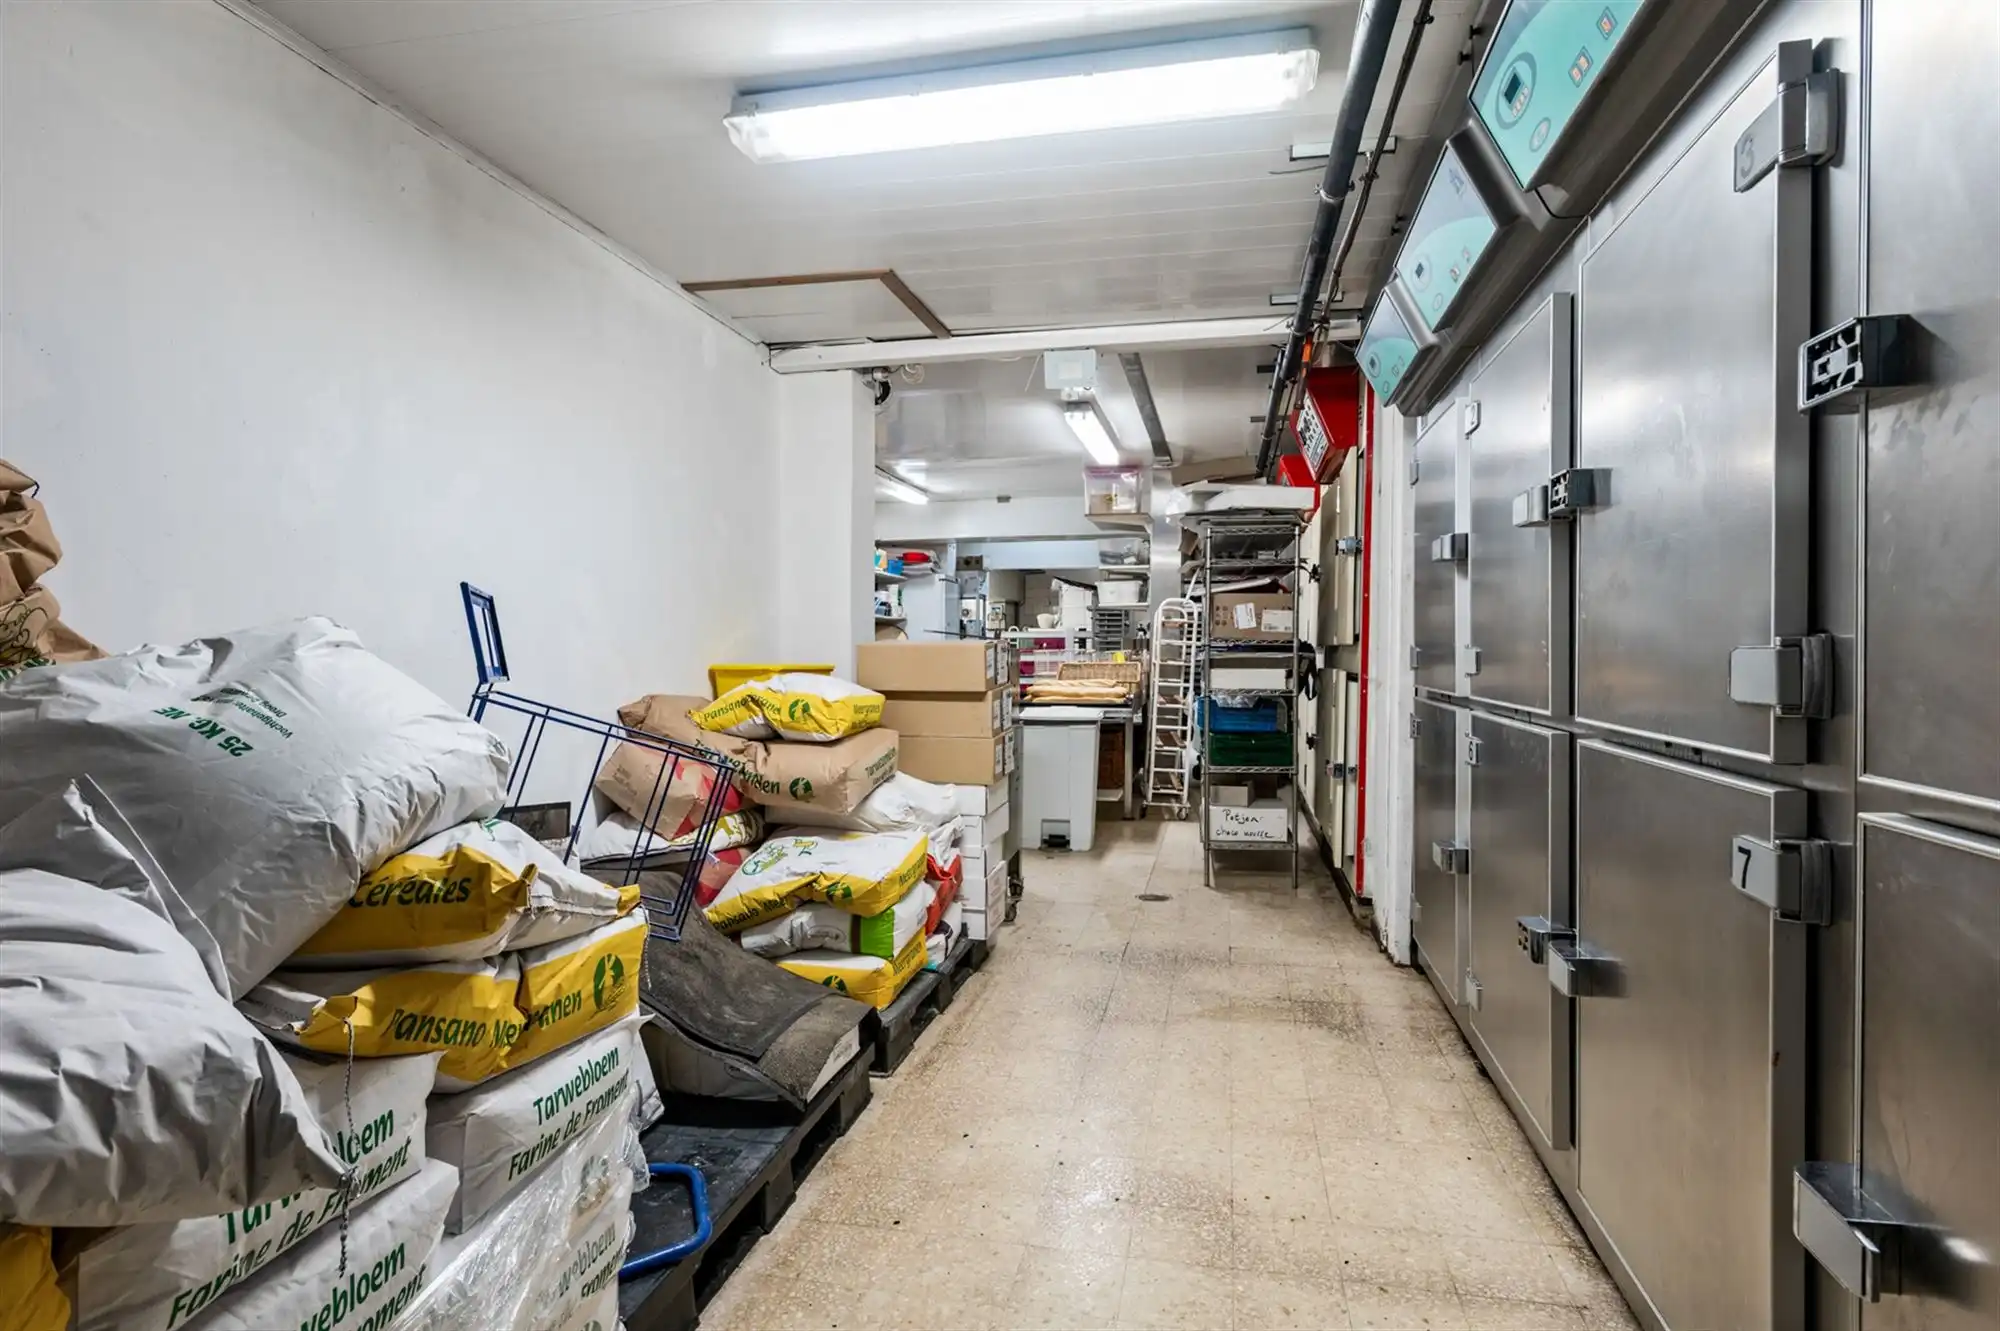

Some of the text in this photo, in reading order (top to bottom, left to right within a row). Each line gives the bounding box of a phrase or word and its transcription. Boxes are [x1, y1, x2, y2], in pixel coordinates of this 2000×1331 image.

[1740, 137, 1755, 180] 3
[217, 736, 254, 758] 25
[1468, 740, 1474, 762] 6
[348, 876, 472, 908] Céréales
[1737, 846, 1751, 890] 7
[380, 1008, 487, 1048] Pansano
[533, 1047, 620, 1126] Tarwebloem
[508, 1068, 629, 1181] Farine de Froment
[219, 1109, 394, 1244] Tarloem
[167, 1239, 272, 1331] Farine
[276, 1209, 315, 1253] de
[300, 1242, 405, 1331] webloem
[357, 1263, 427, 1331] oment
